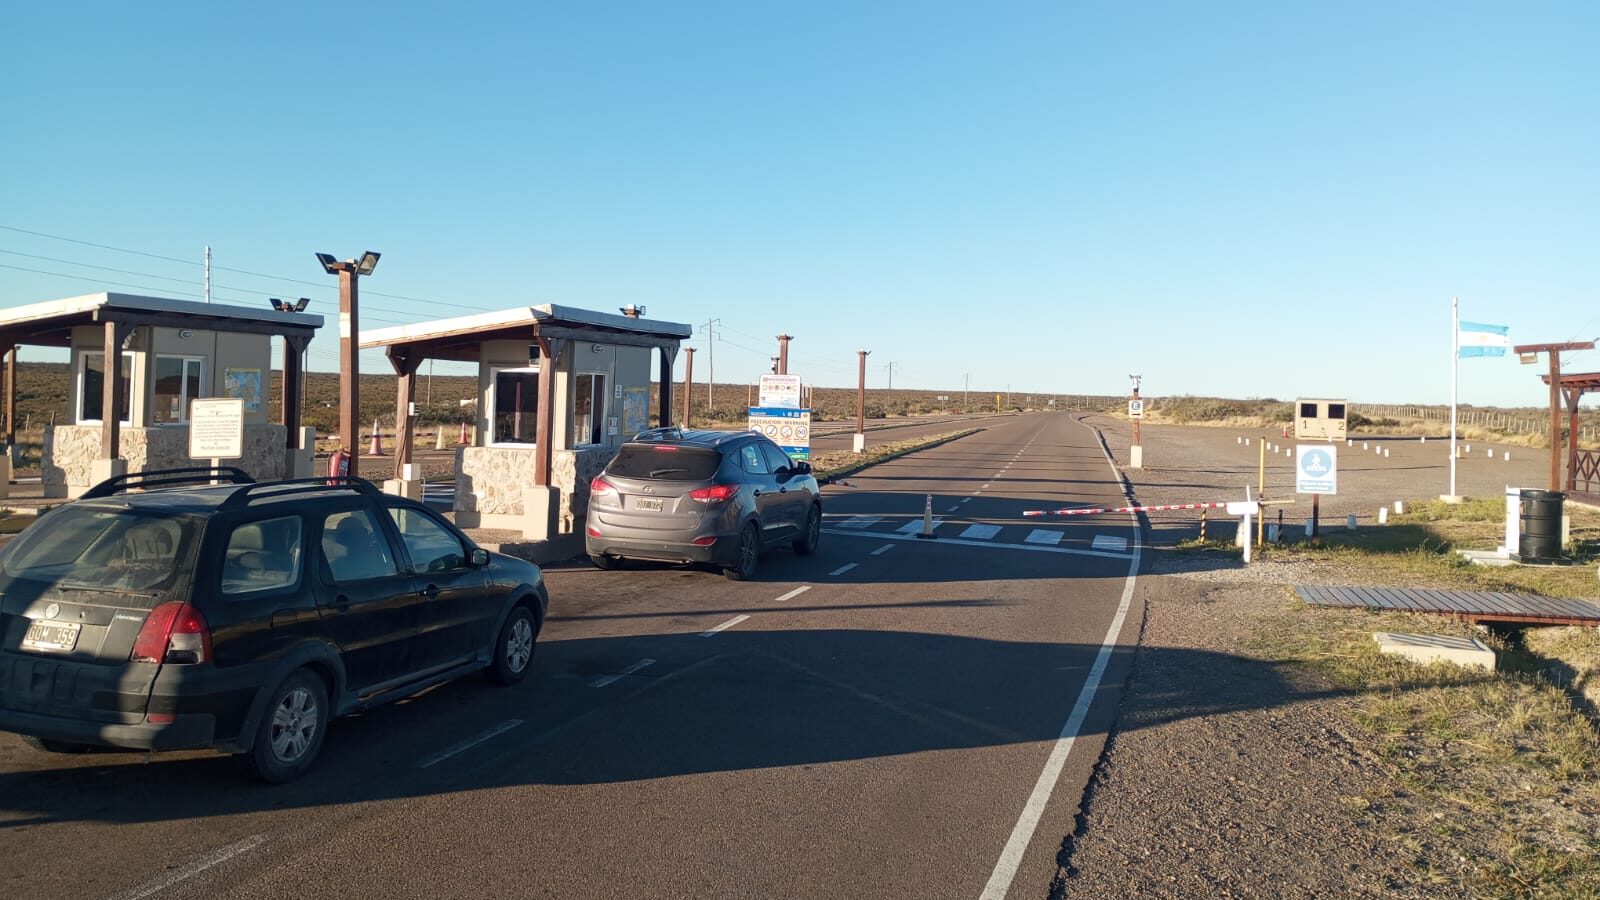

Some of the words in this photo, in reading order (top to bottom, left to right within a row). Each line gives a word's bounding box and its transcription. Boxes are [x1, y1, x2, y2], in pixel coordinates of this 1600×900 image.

[1303, 419, 1307, 429] 1
[1337, 421, 1345, 431] 2
[54, 628, 76, 645] 359
